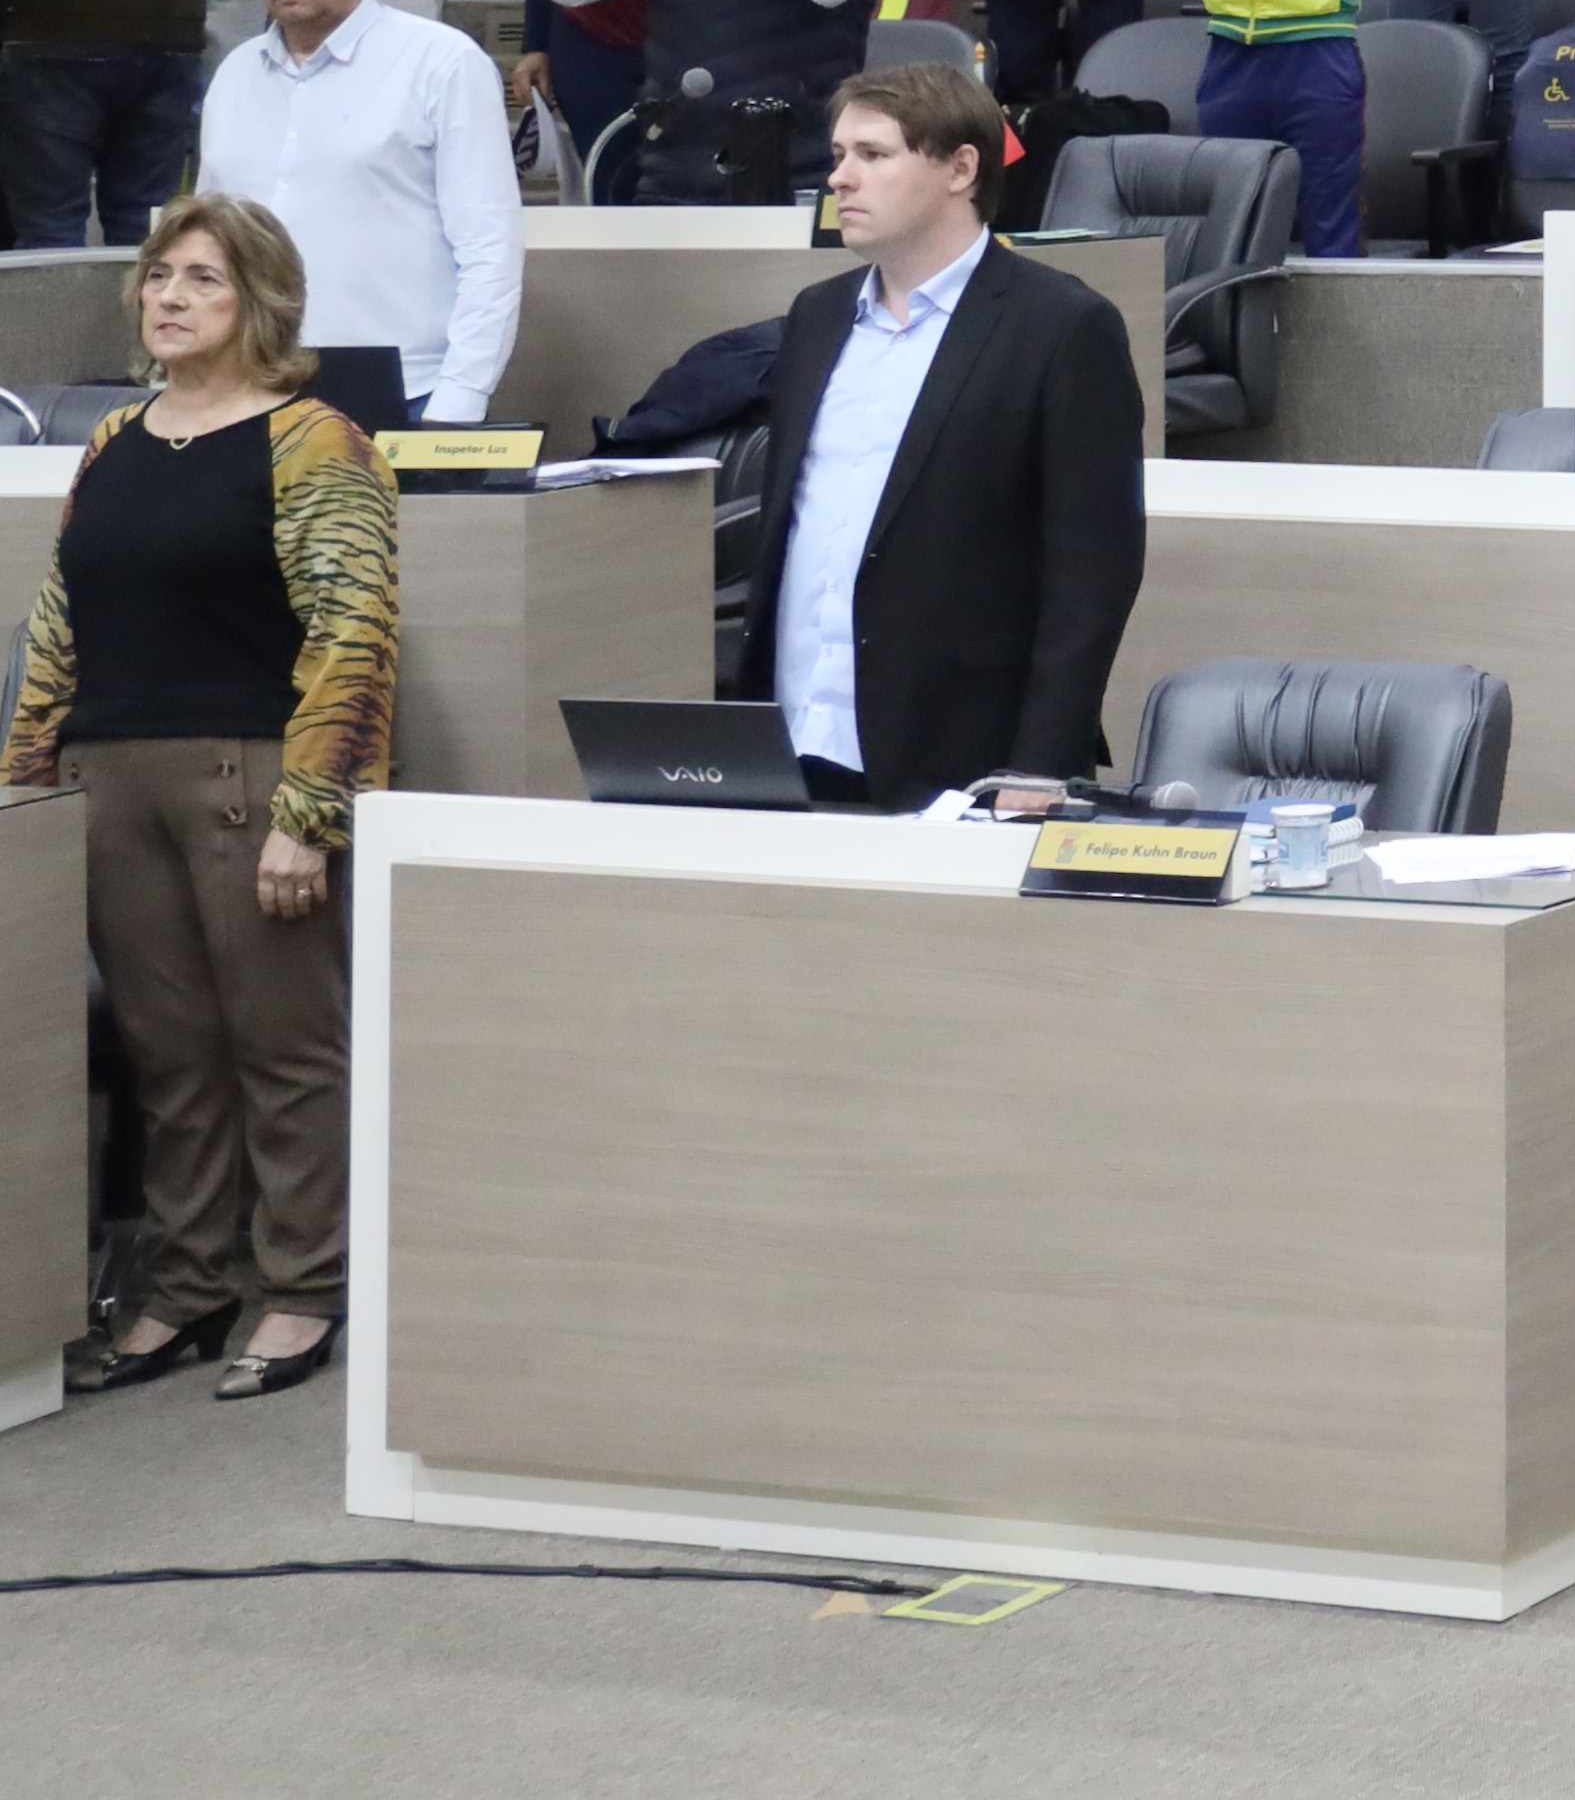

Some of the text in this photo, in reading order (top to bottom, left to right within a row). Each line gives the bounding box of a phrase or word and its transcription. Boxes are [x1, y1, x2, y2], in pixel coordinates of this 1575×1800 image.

[434, 444, 484, 457] Inspetor
[657, 766, 723, 783] VAIO
[1086, 842, 1217, 860] Felipe Kuhn Braun
